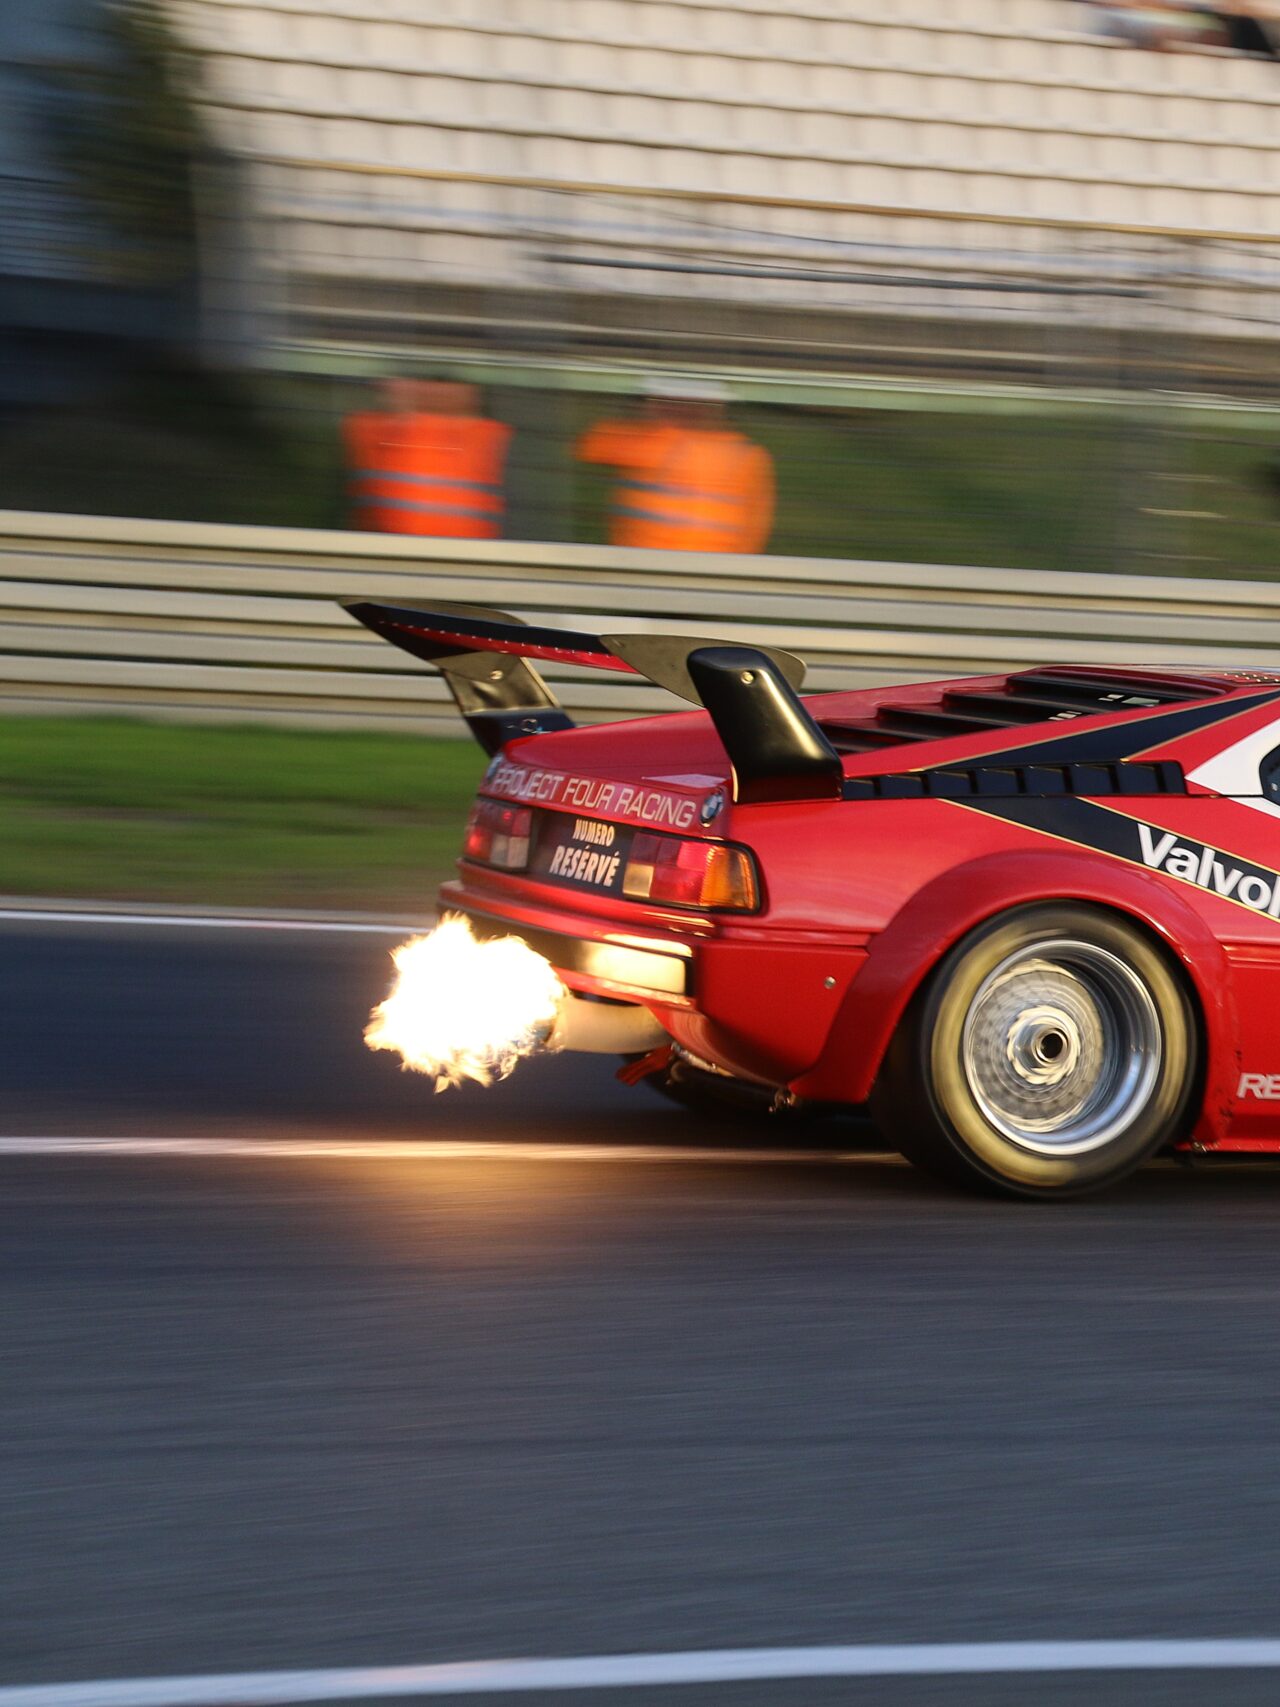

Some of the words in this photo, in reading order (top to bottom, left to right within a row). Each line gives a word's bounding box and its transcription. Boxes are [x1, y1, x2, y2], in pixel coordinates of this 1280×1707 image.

[491, 766, 565, 801] PROJECT
[561, 777, 615, 811] FOUR
[614, 788, 697, 828] RACING
[572, 818, 615, 847] NUMERO
